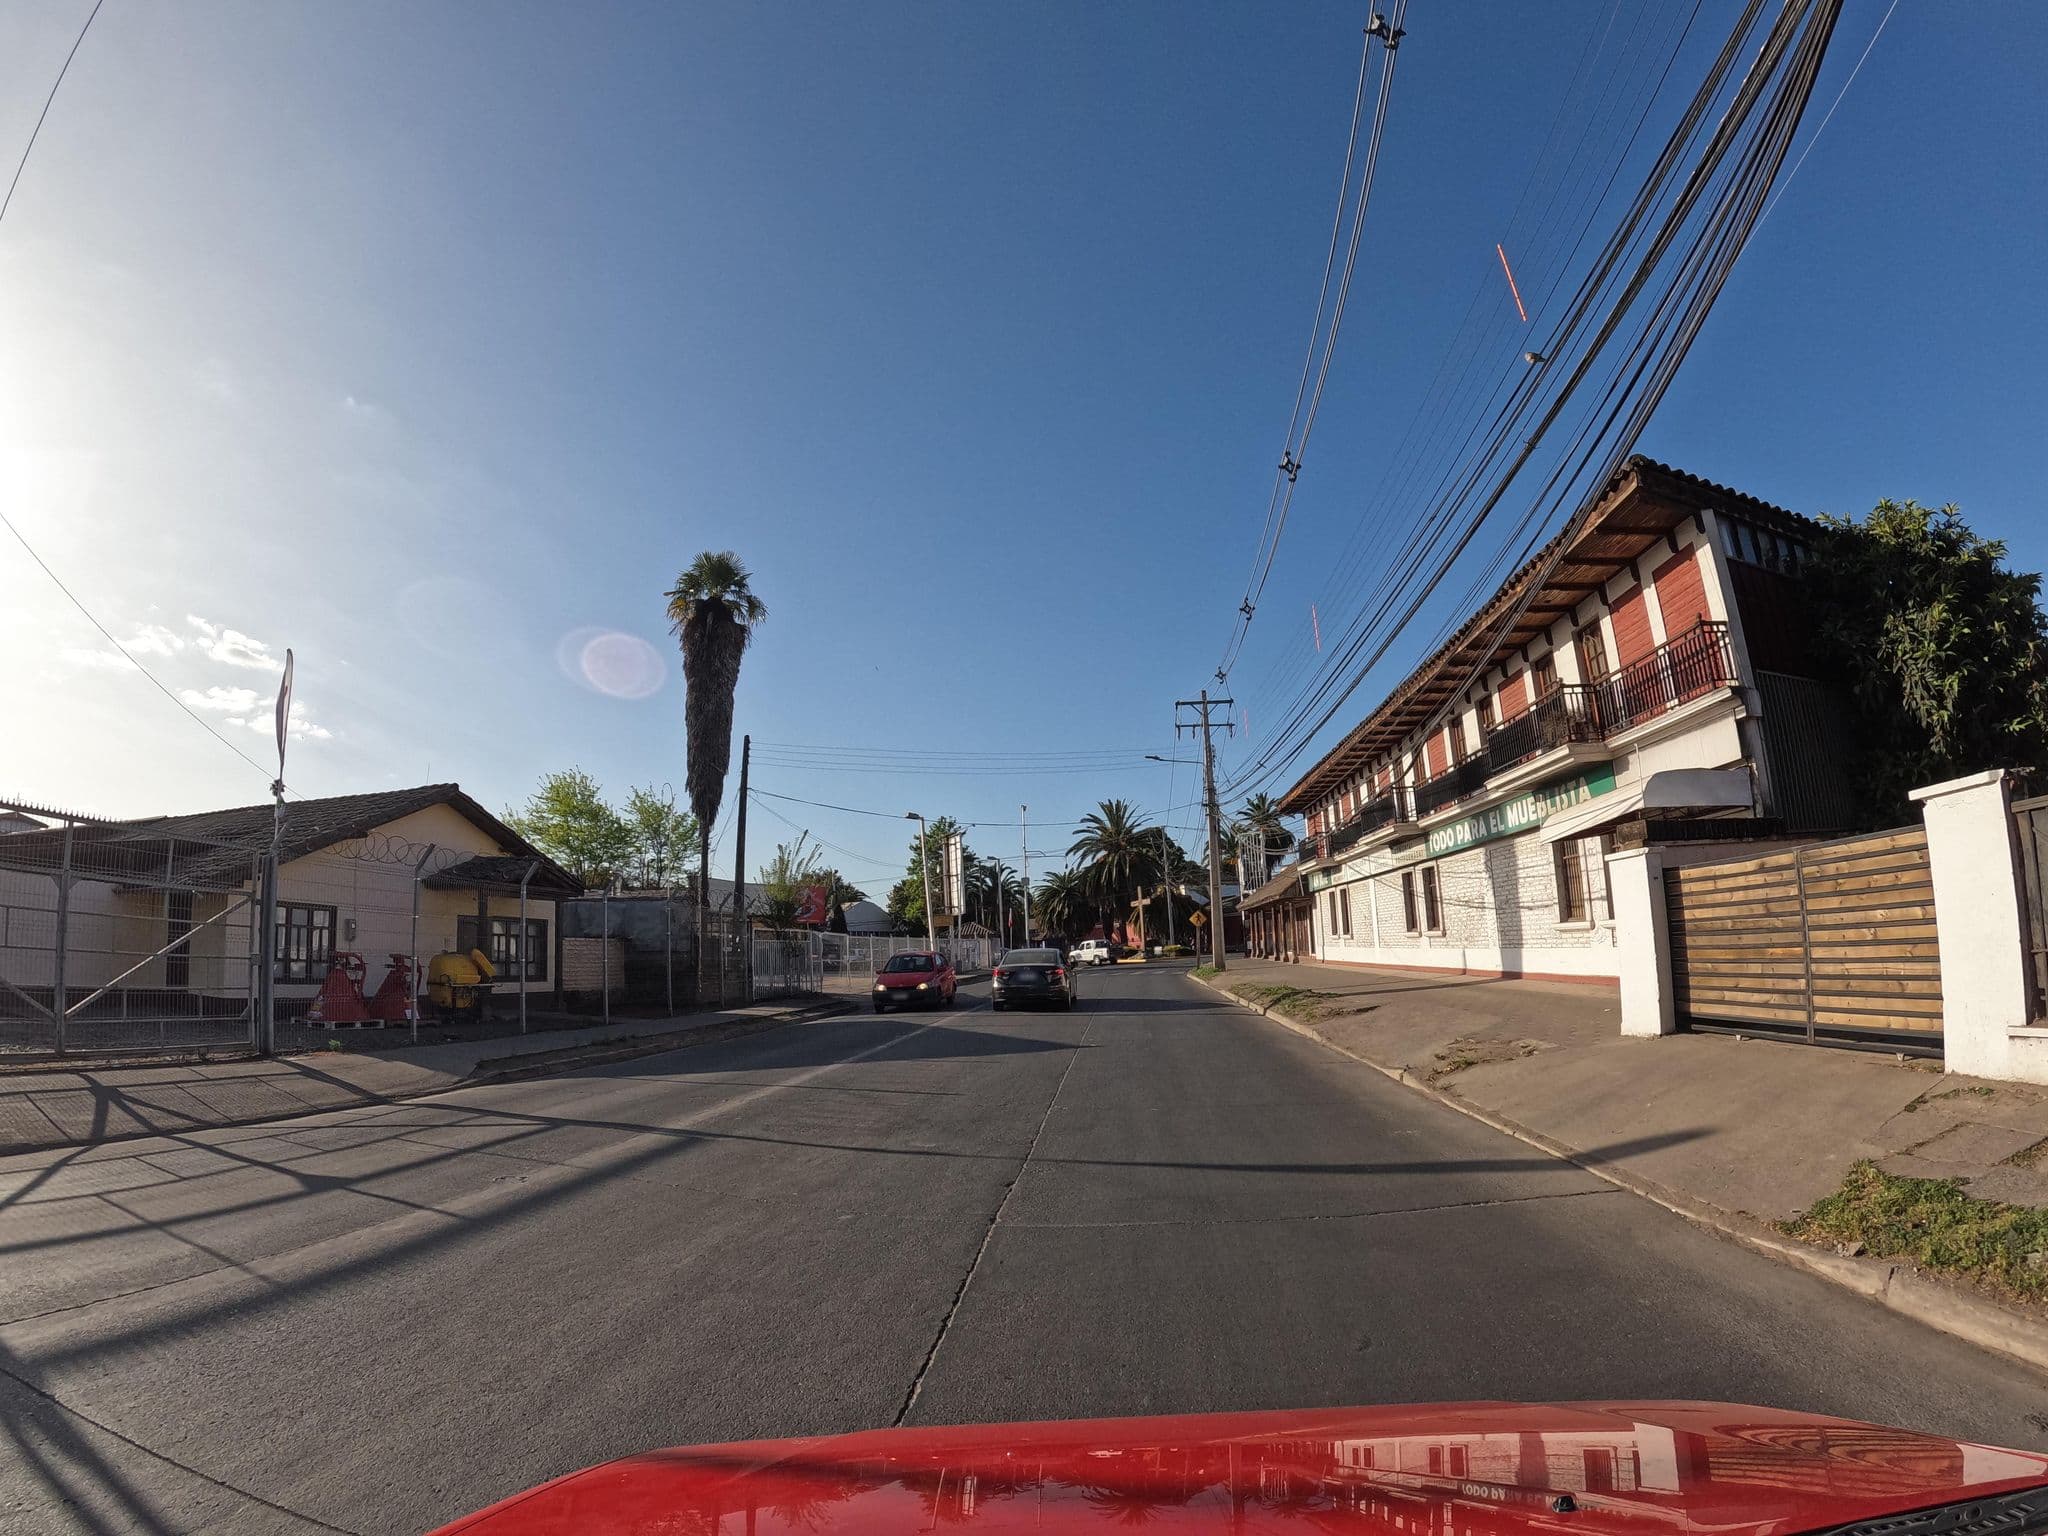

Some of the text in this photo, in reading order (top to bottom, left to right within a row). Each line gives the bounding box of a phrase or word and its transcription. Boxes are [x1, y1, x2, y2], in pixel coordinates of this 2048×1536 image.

[1428, 828, 1454, 853] TODO
[1456, 816, 1488, 845] PARA
[1489, 811, 1505, 834] EL
[1506, 776, 1592, 828] MUEBLISTA
